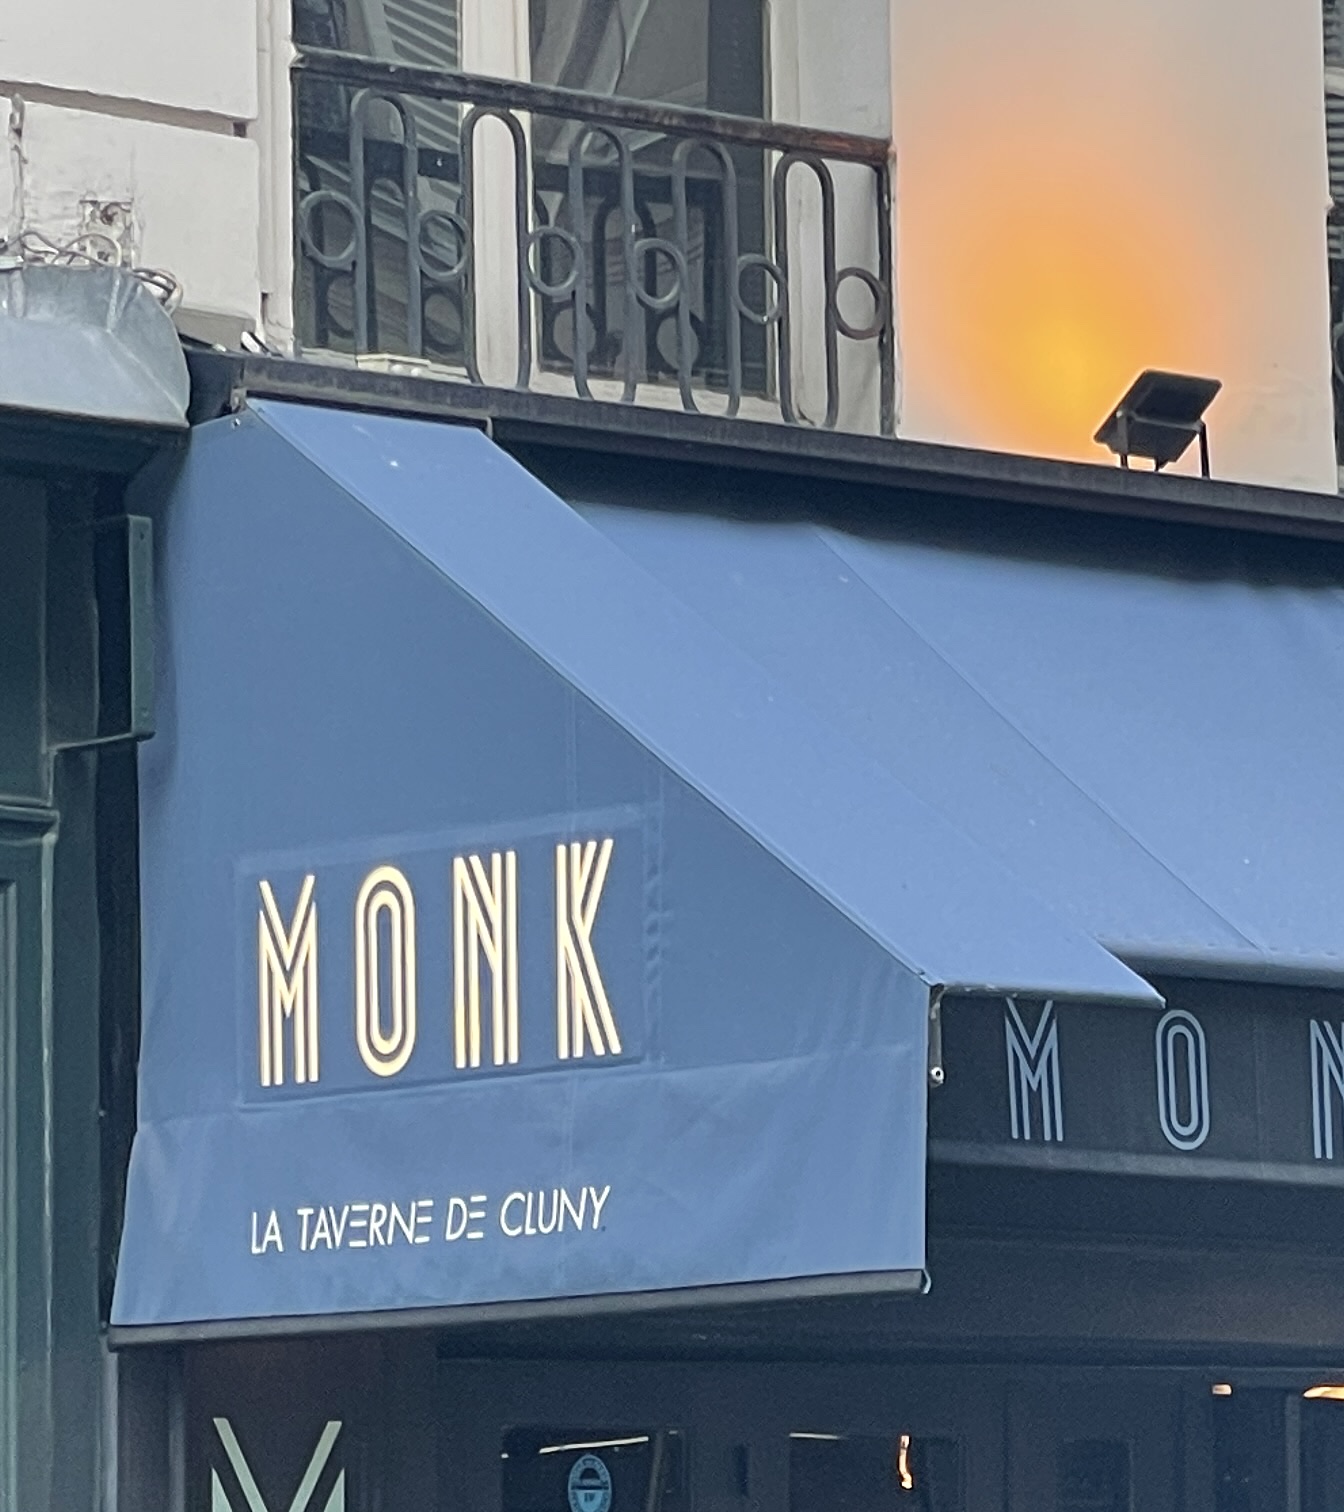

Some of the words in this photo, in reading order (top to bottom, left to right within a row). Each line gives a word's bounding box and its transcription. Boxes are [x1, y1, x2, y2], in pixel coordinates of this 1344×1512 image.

[258, 838, 622, 1088] MONK
[251, 1208, 282, 1256] LA
[298, 1198, 432, 1252] TAVERNE
[445, 1194, 486, 1242] DE
[498, 1186, 611, 1239] CLUNY
